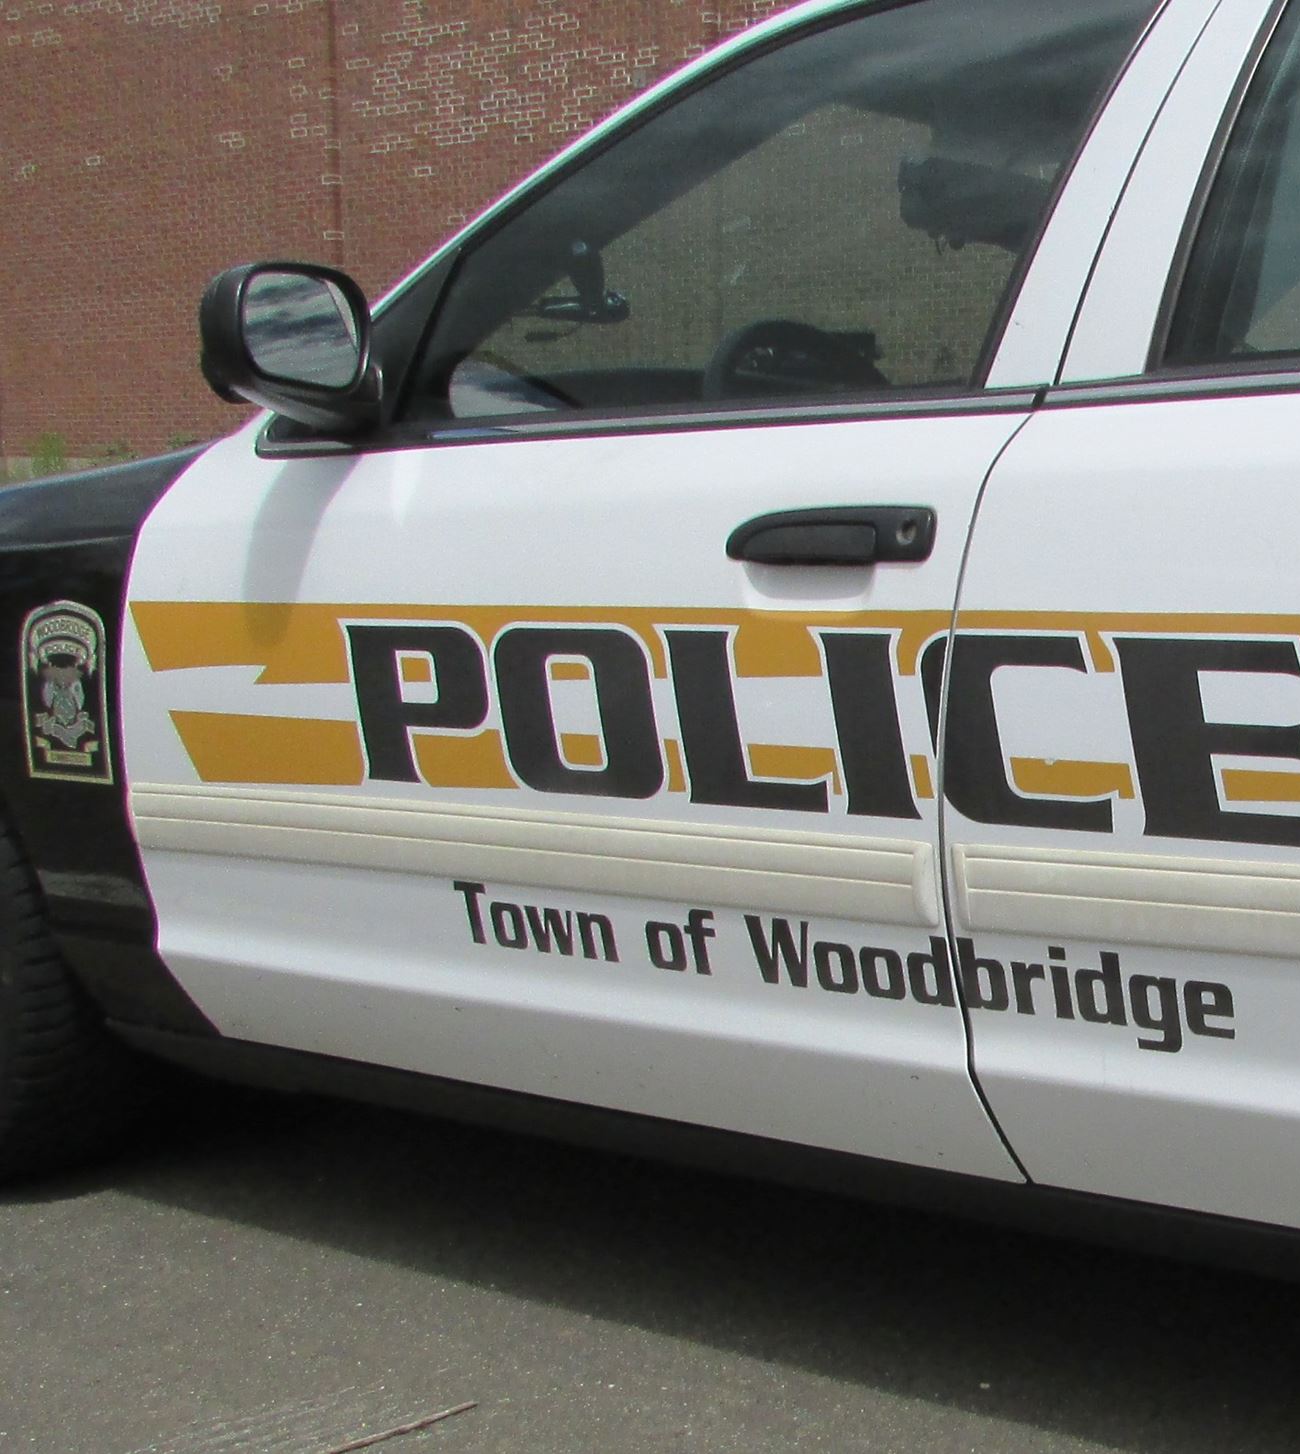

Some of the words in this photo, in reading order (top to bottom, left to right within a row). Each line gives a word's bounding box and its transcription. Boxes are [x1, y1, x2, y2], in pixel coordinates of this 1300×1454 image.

[454, 881, 618, 963] Town
[646, 909, 715, 974] of
[744, 915, 1235, 1052] Woodbridge
